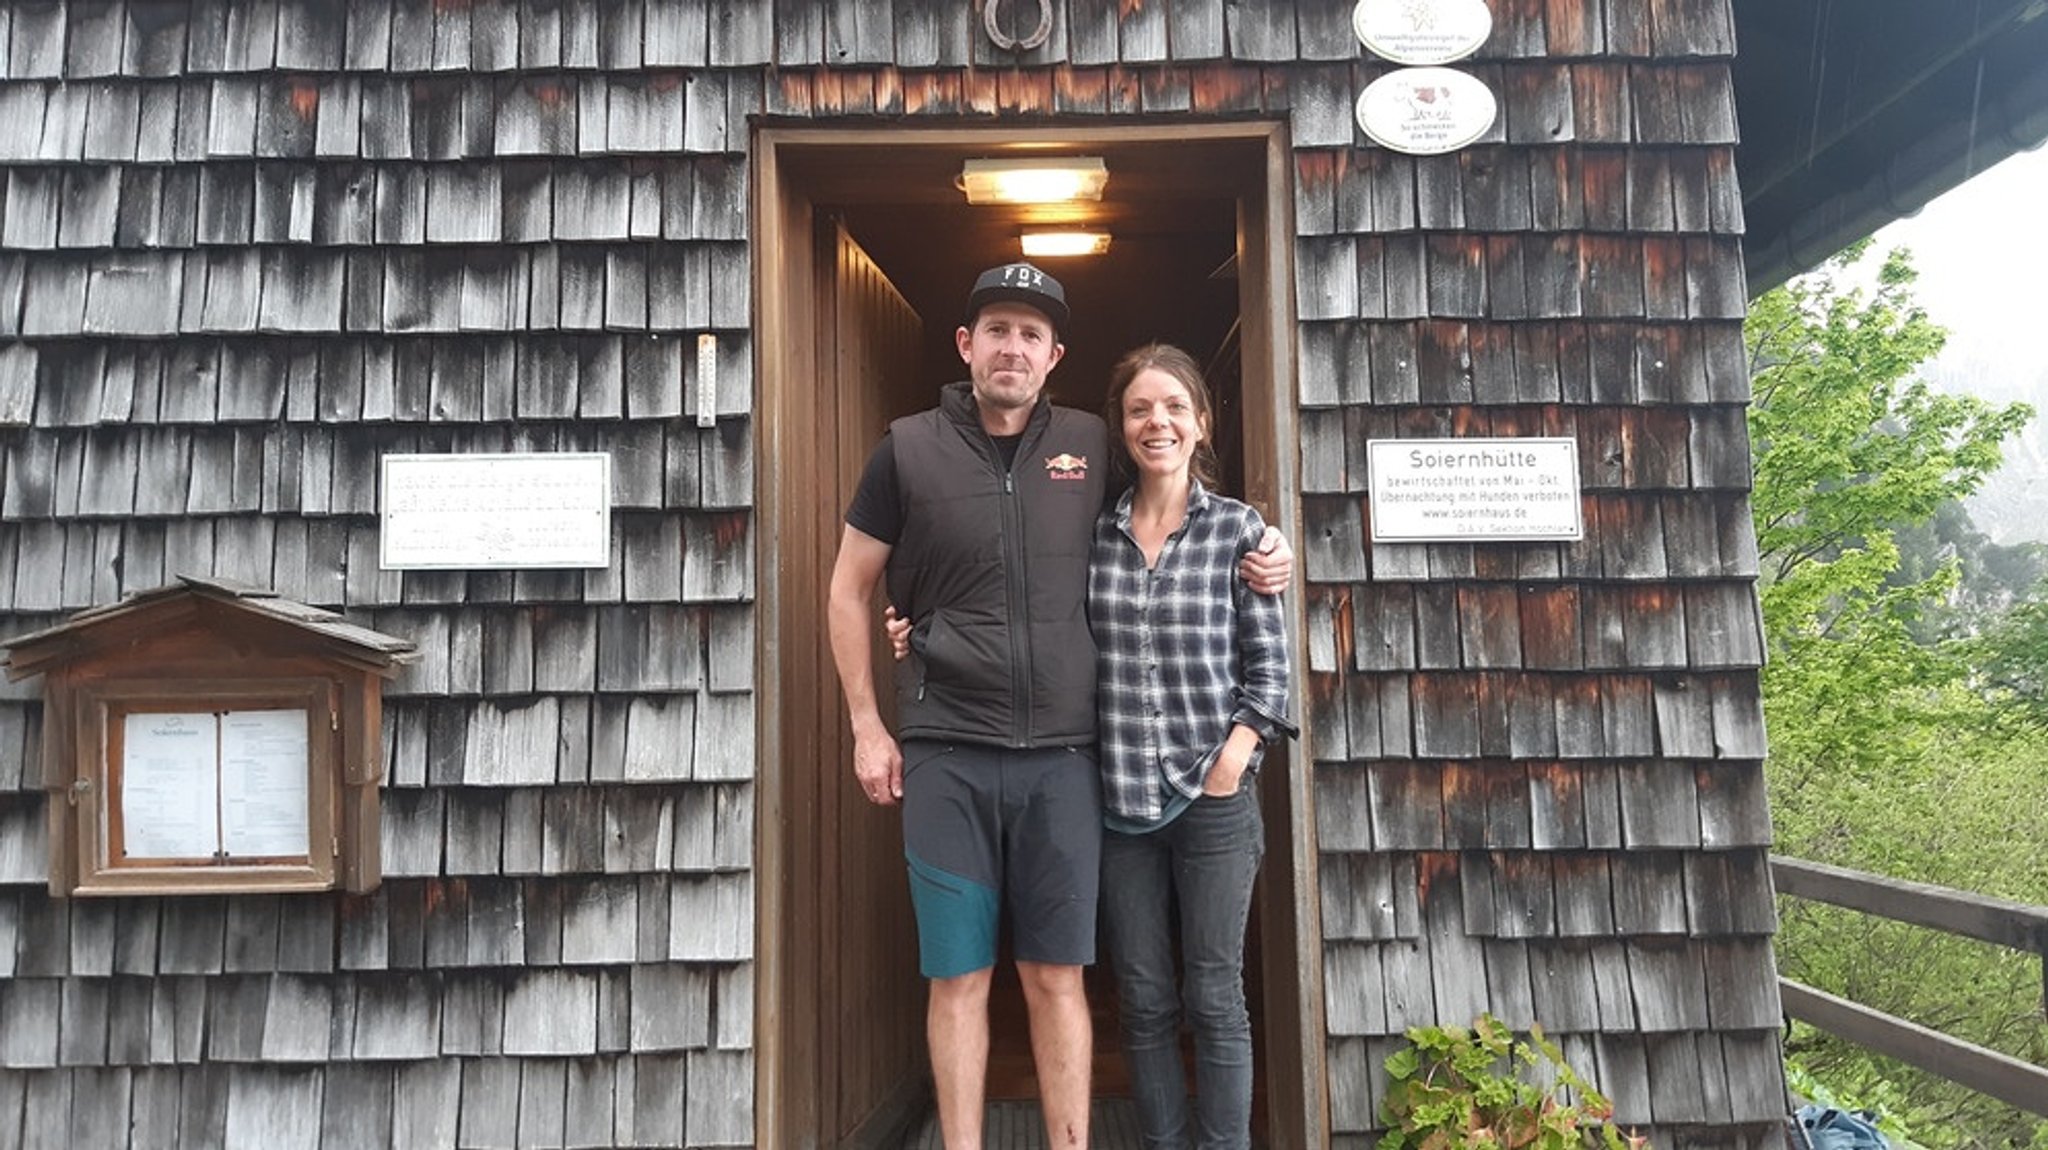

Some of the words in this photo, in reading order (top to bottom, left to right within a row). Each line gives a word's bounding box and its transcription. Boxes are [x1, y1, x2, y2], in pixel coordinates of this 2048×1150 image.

[1004, 267, 1043, 287] FOX
[1409, 448, 1538, 469] Soiernhütte
[1386, 475, 1476, 487] bewirtschaftet
[1479, 477, 1500, 487] von
[1380, 489, 1456, 505] Übernachtung
[1458, 491, 1477, 502] mit
[1479, 490, 1520, 502] Hunden
[1522, 490, 1571, 502] verboten
[1421, 506, 1528, 519] www.soiernhaus.de
